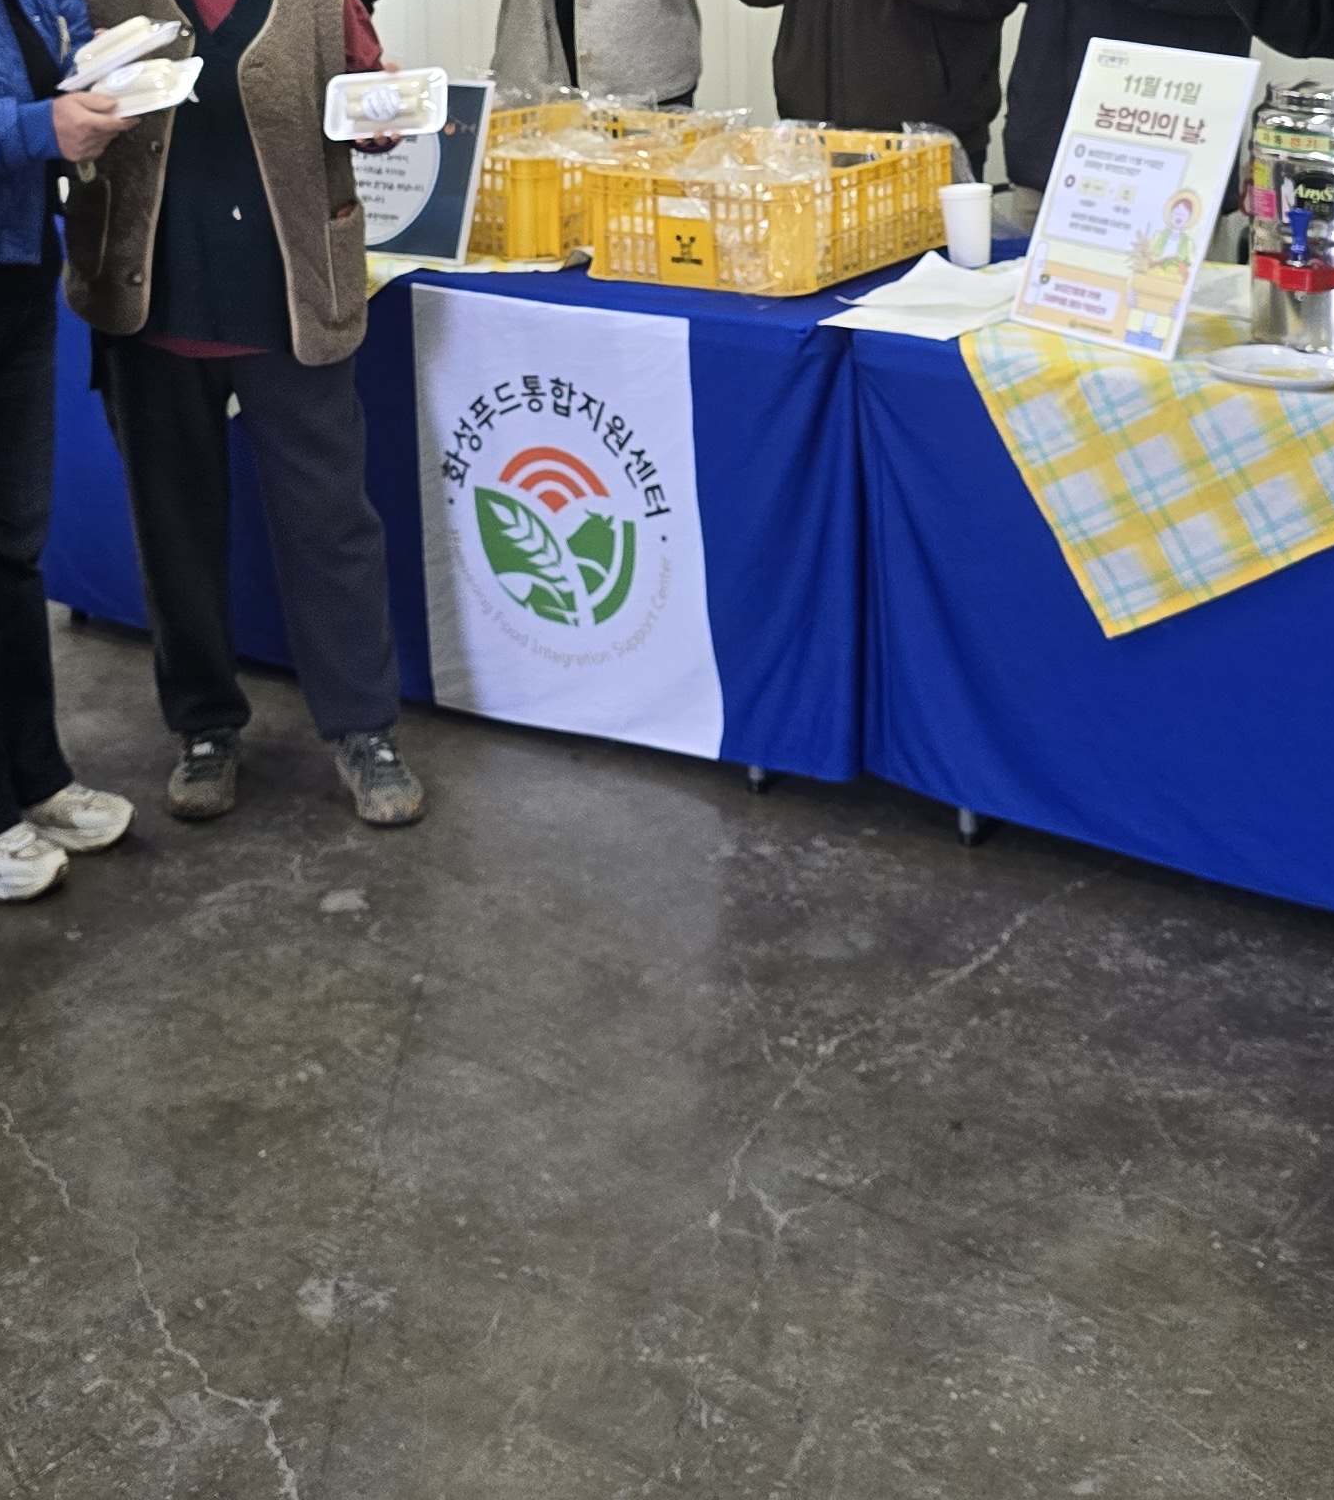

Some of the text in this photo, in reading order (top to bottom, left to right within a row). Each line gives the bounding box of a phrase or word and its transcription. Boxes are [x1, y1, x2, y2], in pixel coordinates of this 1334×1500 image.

[1123, 74, 1202, 105] 11월 11일
[1094, 103, 1179, 140] 농업인의
[441, 374, 671, 518] 화성푸드통합지원센터
